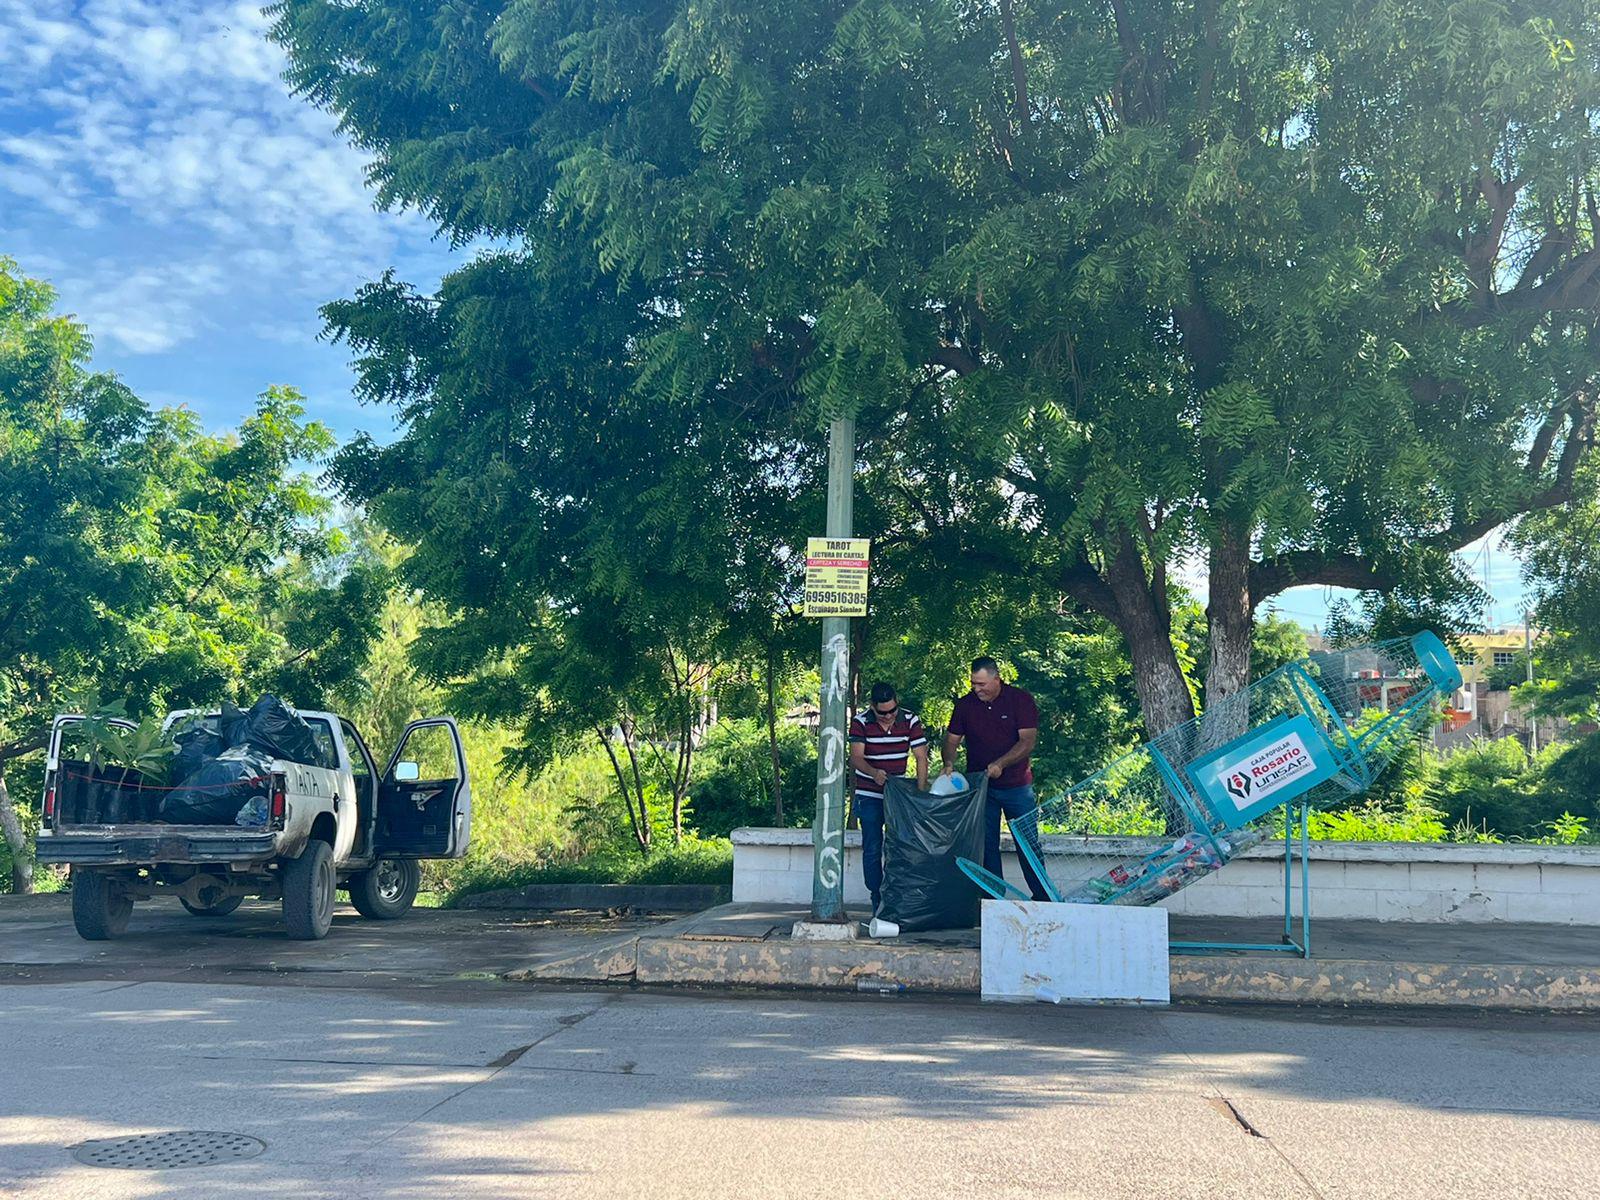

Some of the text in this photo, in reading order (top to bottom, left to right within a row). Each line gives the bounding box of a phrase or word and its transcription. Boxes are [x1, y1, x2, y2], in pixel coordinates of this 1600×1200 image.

[826, 541, 851, 550] TAROT
[811, 551, 835, 559] LECTURA
[805, 591, 866, 605] 6959516385
[808, 605, 839, 614] Escuinapa
[1251, 741, 1291, 766] CAJA POPULAR
[1251, 747, 1301, 778] Rosario
[1255, 755, 1307, 788] UNISAP
